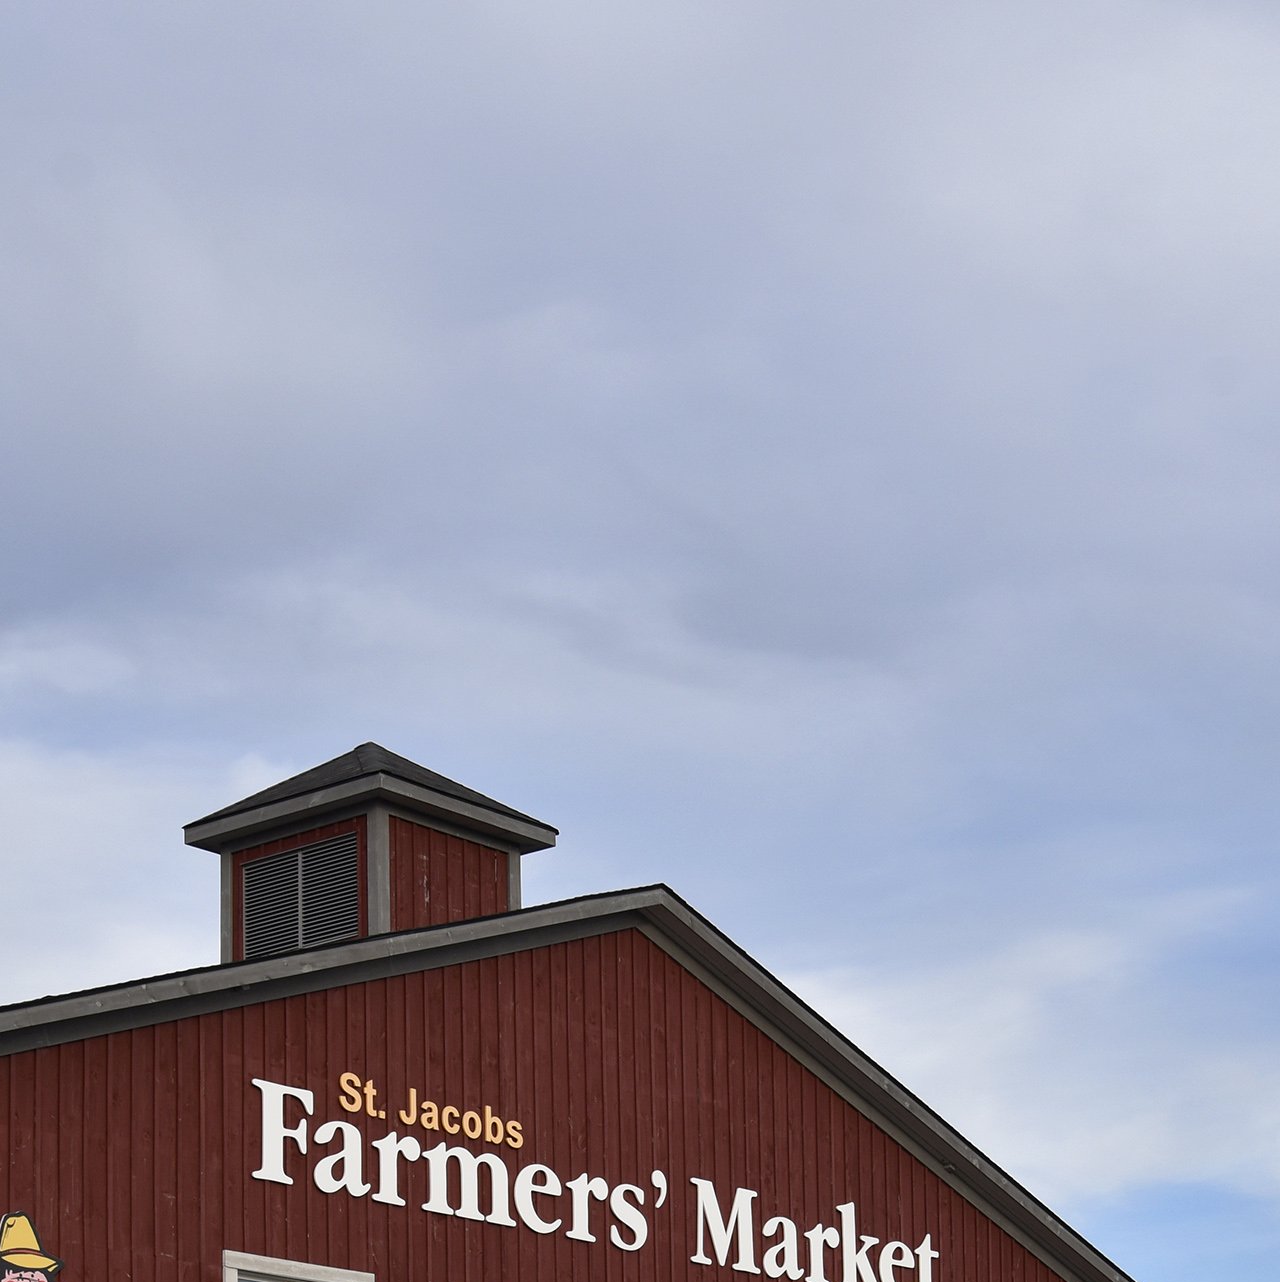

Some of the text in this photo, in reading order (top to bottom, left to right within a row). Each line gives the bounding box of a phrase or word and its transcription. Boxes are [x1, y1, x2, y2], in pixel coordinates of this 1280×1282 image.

[250, 1077, 668, 1252] Farmers'
[338, 1072, 524, 1149] St. Jacobs
